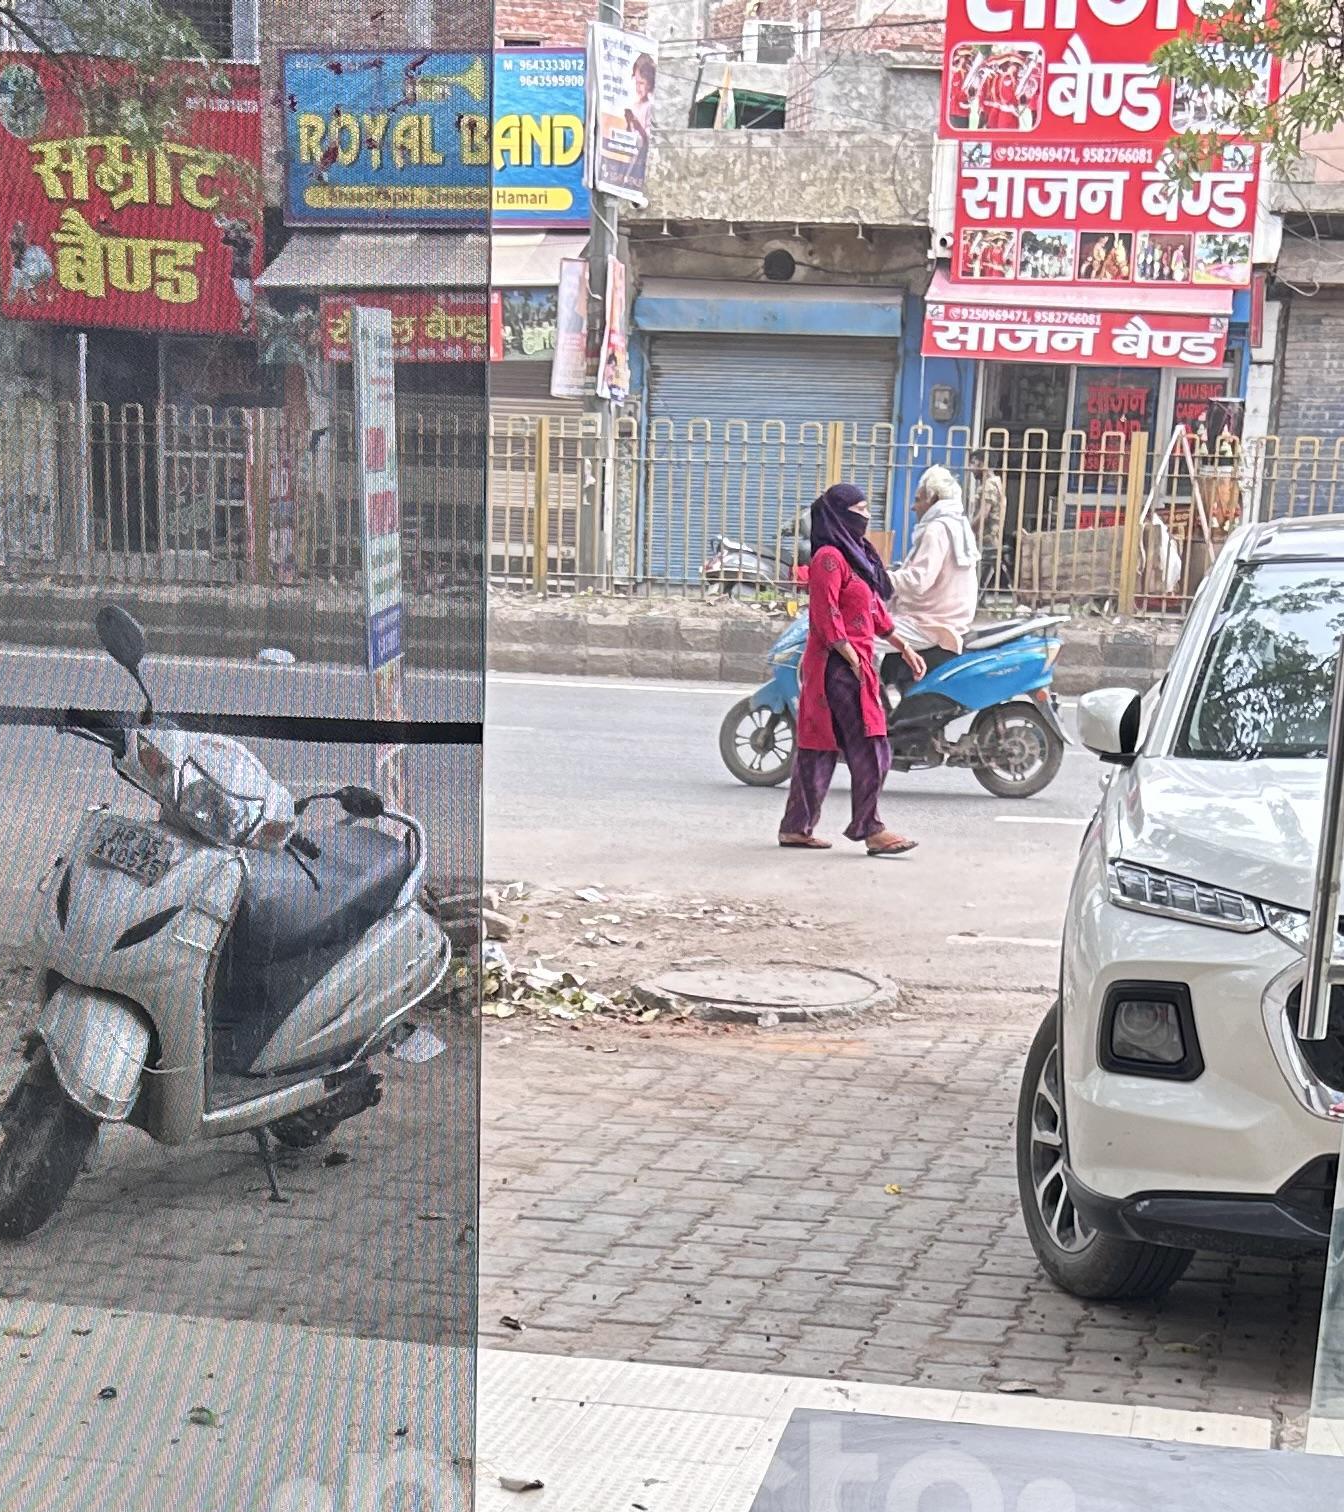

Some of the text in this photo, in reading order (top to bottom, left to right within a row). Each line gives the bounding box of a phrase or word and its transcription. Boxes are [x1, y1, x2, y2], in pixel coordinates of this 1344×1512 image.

[1047, 33, 1162, 132] बैण्ड
[297, 111, 585, 172] ROYAL BAND
[497, 190, 547, 205] Hamari
[961, 168, 1130, 221] साजन
[50, 206, 204, 305] बैण्ड
[932, 315, 1225, 364] साजन बैण्ड
